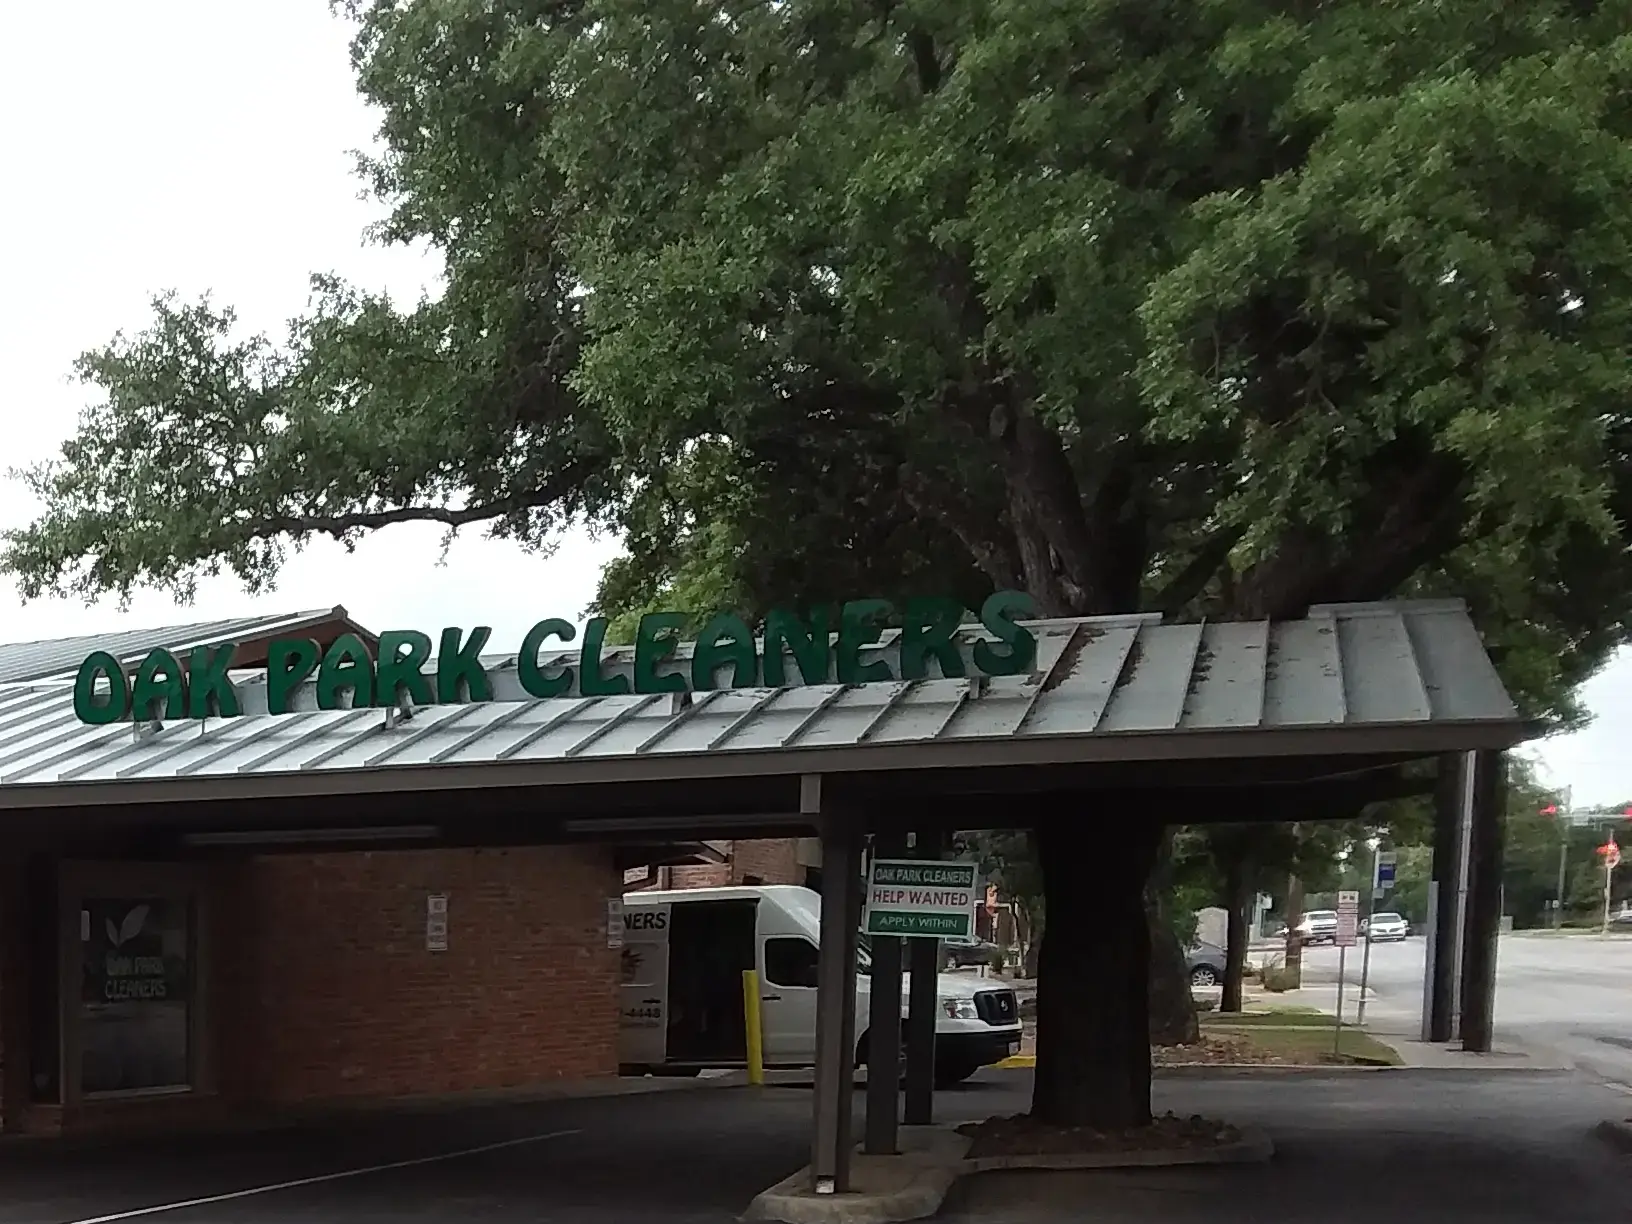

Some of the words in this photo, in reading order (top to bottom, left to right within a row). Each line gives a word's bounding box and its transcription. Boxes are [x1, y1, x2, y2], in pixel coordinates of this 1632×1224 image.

[74, 644, 242, 724] OAK
[268, 626, 494, 716] PARK
[516, 589, 1039, 699] CLEANERS
[875, 868, 895, 881] OAK
[897, 868, 921, 882] PARK
[923, 870, 971, 884] CLEANERS
[873, 889, 905, 904] HELP
[909, 891, 968, 907] WANTED
[879, 916, 915, 928] APPLY
[918, 918, 958, 929] WITHIN
